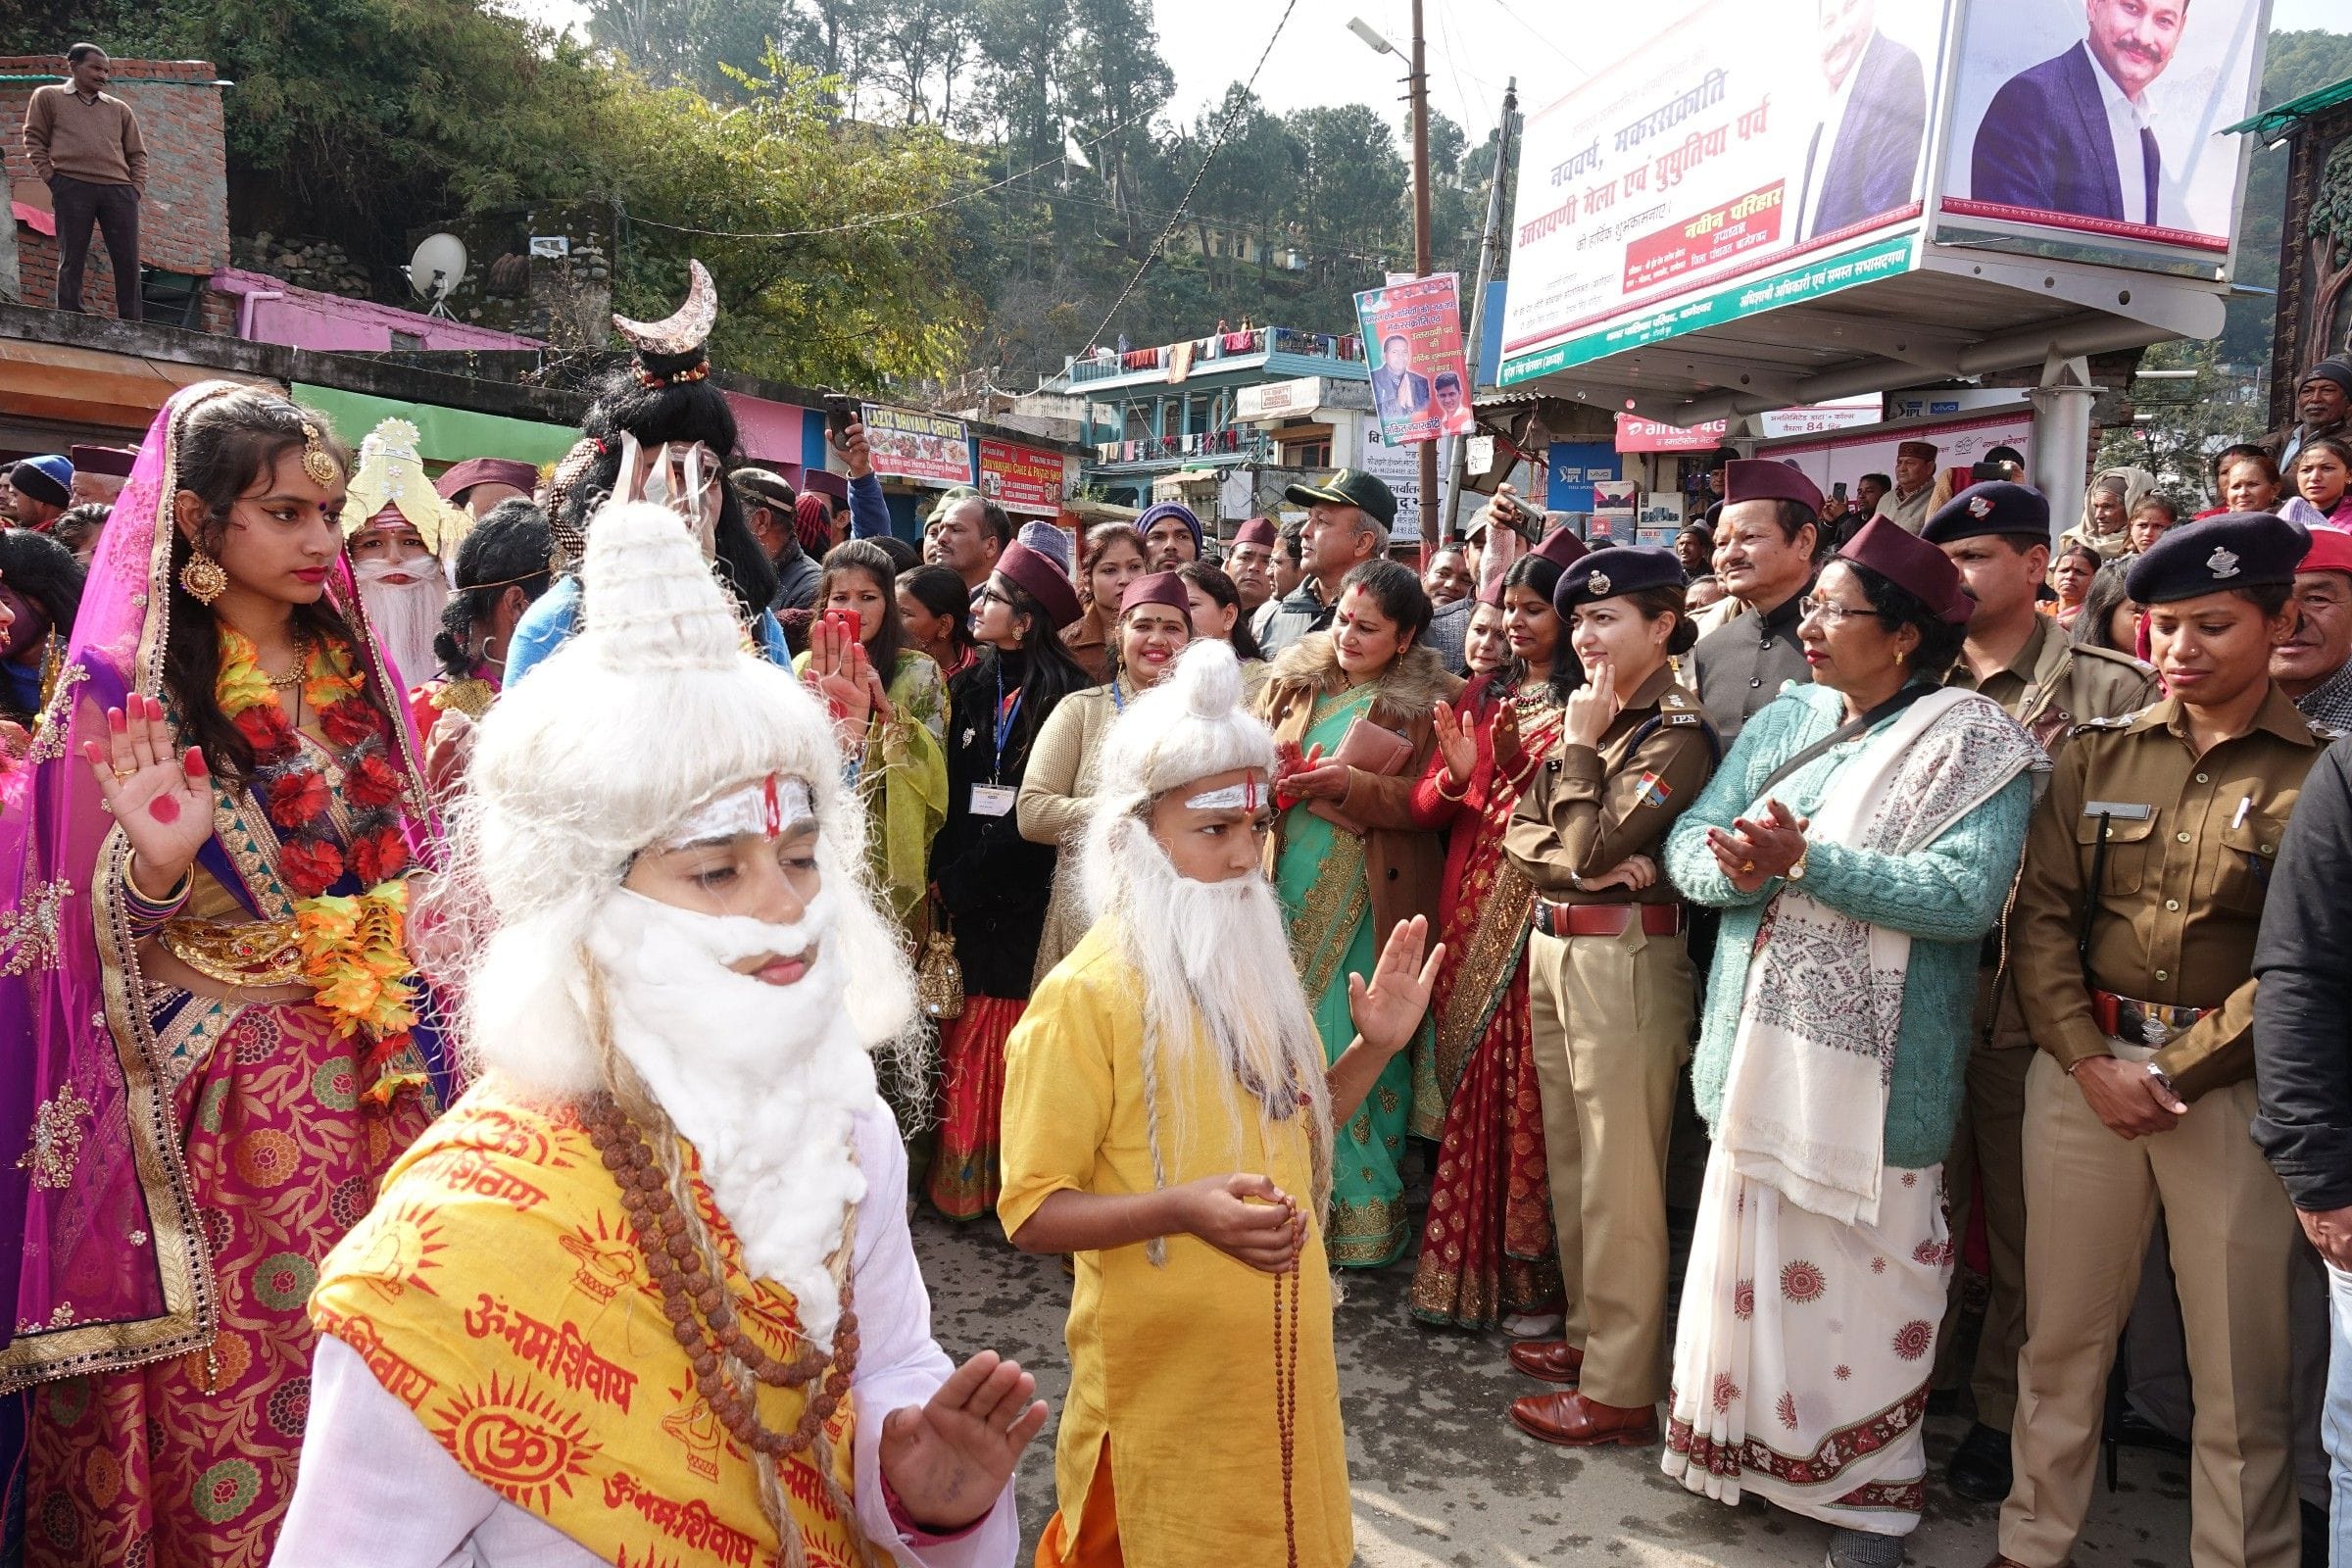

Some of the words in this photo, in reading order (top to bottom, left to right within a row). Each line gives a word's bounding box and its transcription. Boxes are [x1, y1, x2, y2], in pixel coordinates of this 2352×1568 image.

[1584, 180, 1617, 215] मेला
[1624, 154, 1652, 197] एवं
[1737, 92, 1771, 141] पर्व
[1730, 186, 1785, 220] परिहार
[867, 409, 895, 428] LAZIZ
[895, 412, 930, 434] BRIYANI
[931, 418, 962, 439] CENTER
[1701, 419, 1725, 432] 4G
[1807, 421, 1823, 431] 84
[1671, 714, 1696, 724] IPS
[549, 1320, 638, 1416] शिवाय
[672, 1498, 759, 1568] शिवाय
